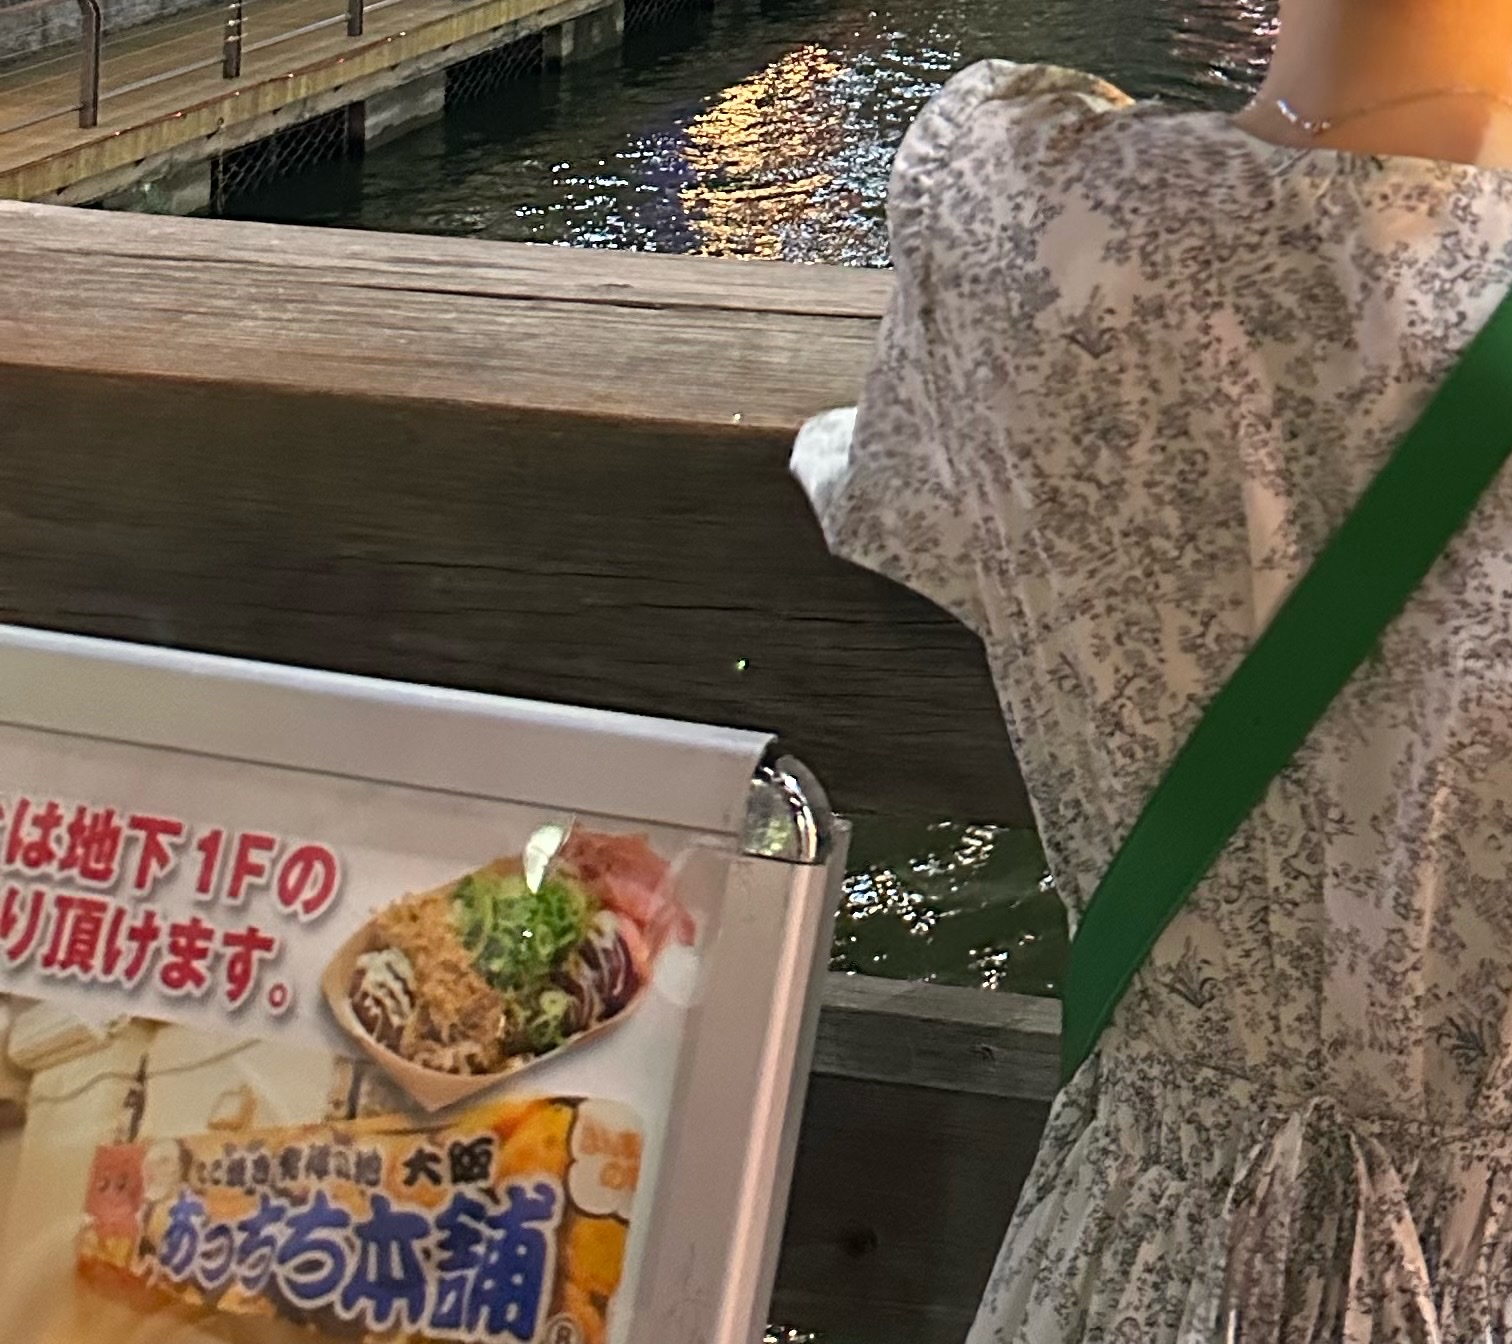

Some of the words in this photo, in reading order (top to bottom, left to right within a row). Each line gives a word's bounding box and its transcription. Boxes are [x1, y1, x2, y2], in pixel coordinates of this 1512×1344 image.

[0, 798, 337, 914] は地下1Fの
[0, 886, 290, 1007] り頂けます。
[160, 1183, 558, 1340] あっちち本舗
